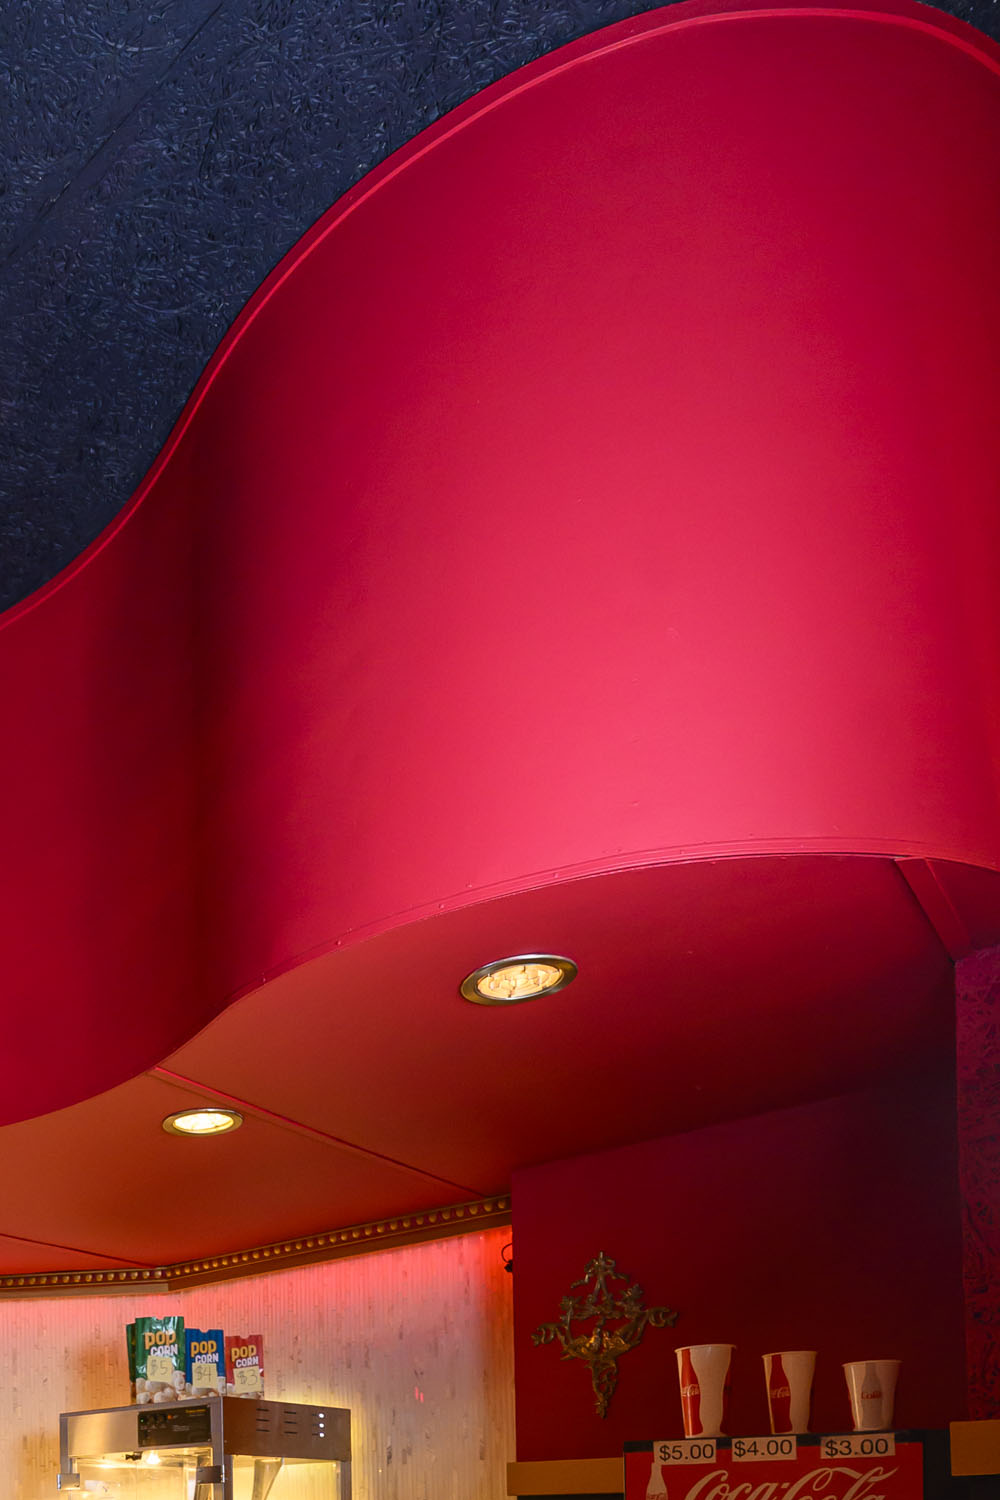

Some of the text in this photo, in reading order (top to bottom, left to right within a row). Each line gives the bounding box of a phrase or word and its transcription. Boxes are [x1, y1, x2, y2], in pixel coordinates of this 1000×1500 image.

[150, 1344, 178, 1357] CORN
[195, 1352, 219, 1364] CORN
[150, 1359, 168, 1376] $5
[235, 1356, 259, 1368] CORN
[194, 1364, 212, 1382] $4
[237, 1367, 258, 1386] $3
[659, 1443, 715, 1461] $5.00
[734, 1439, 793, 1457] $4.00
[825, 1438, 889, 1457] $3.00
